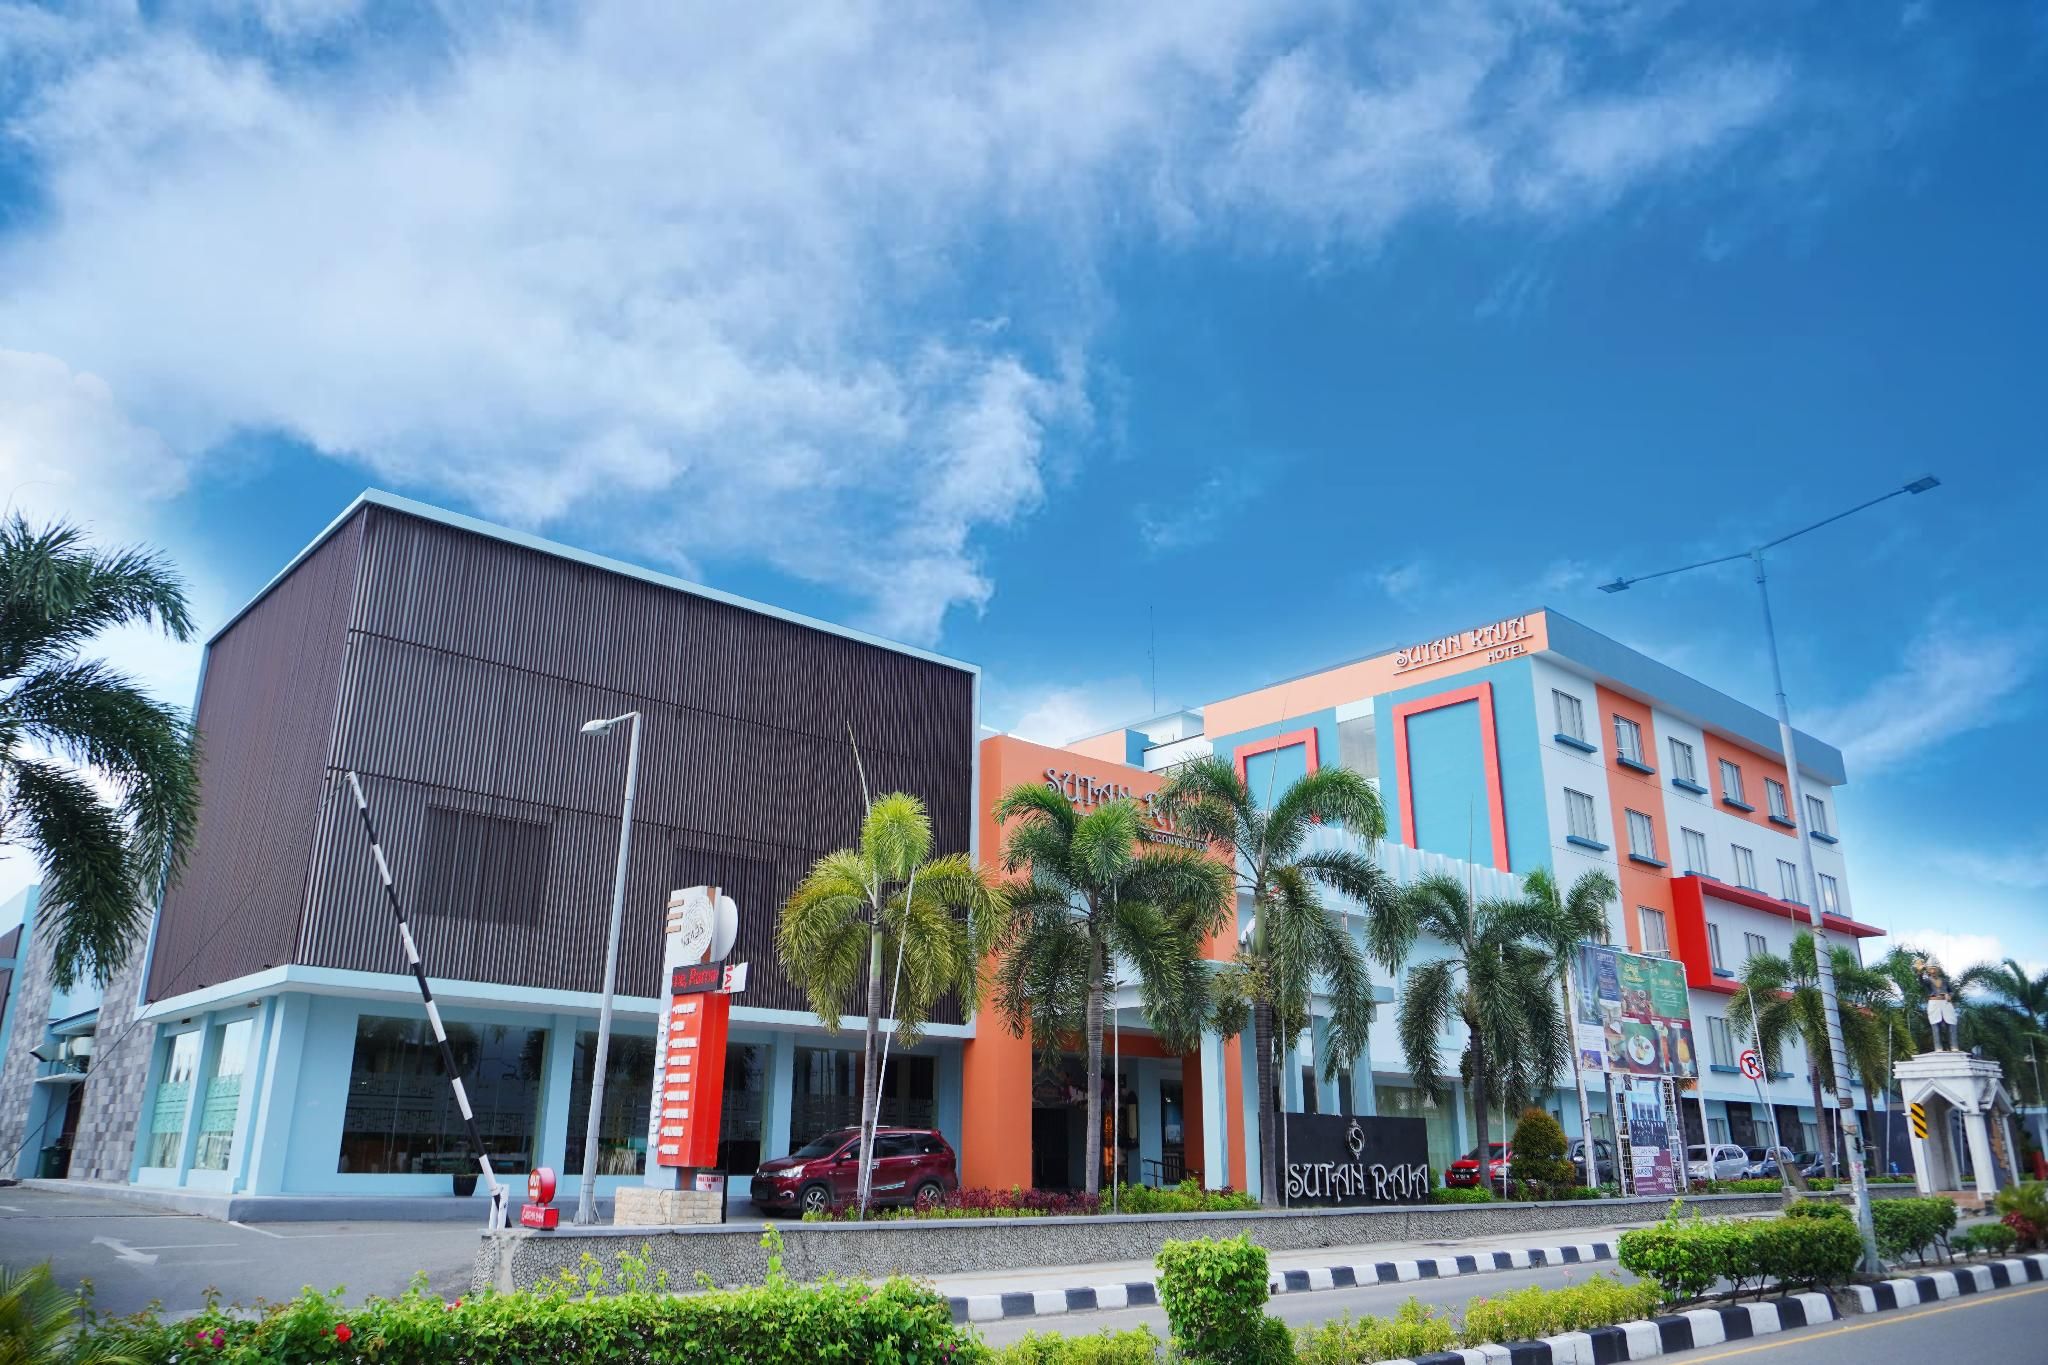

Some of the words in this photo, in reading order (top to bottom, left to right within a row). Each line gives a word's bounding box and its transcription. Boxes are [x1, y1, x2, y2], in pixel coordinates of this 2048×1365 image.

[1394, 635, 1462, 667] SUTAN
[1470, 616, 1527, 647] RAJA
[1488, 644, 1527, 663] HOTEL
[1288, 1160, 1366, 1202] SUTAN
[1369, 1163, 1429, 1201] RAJA
